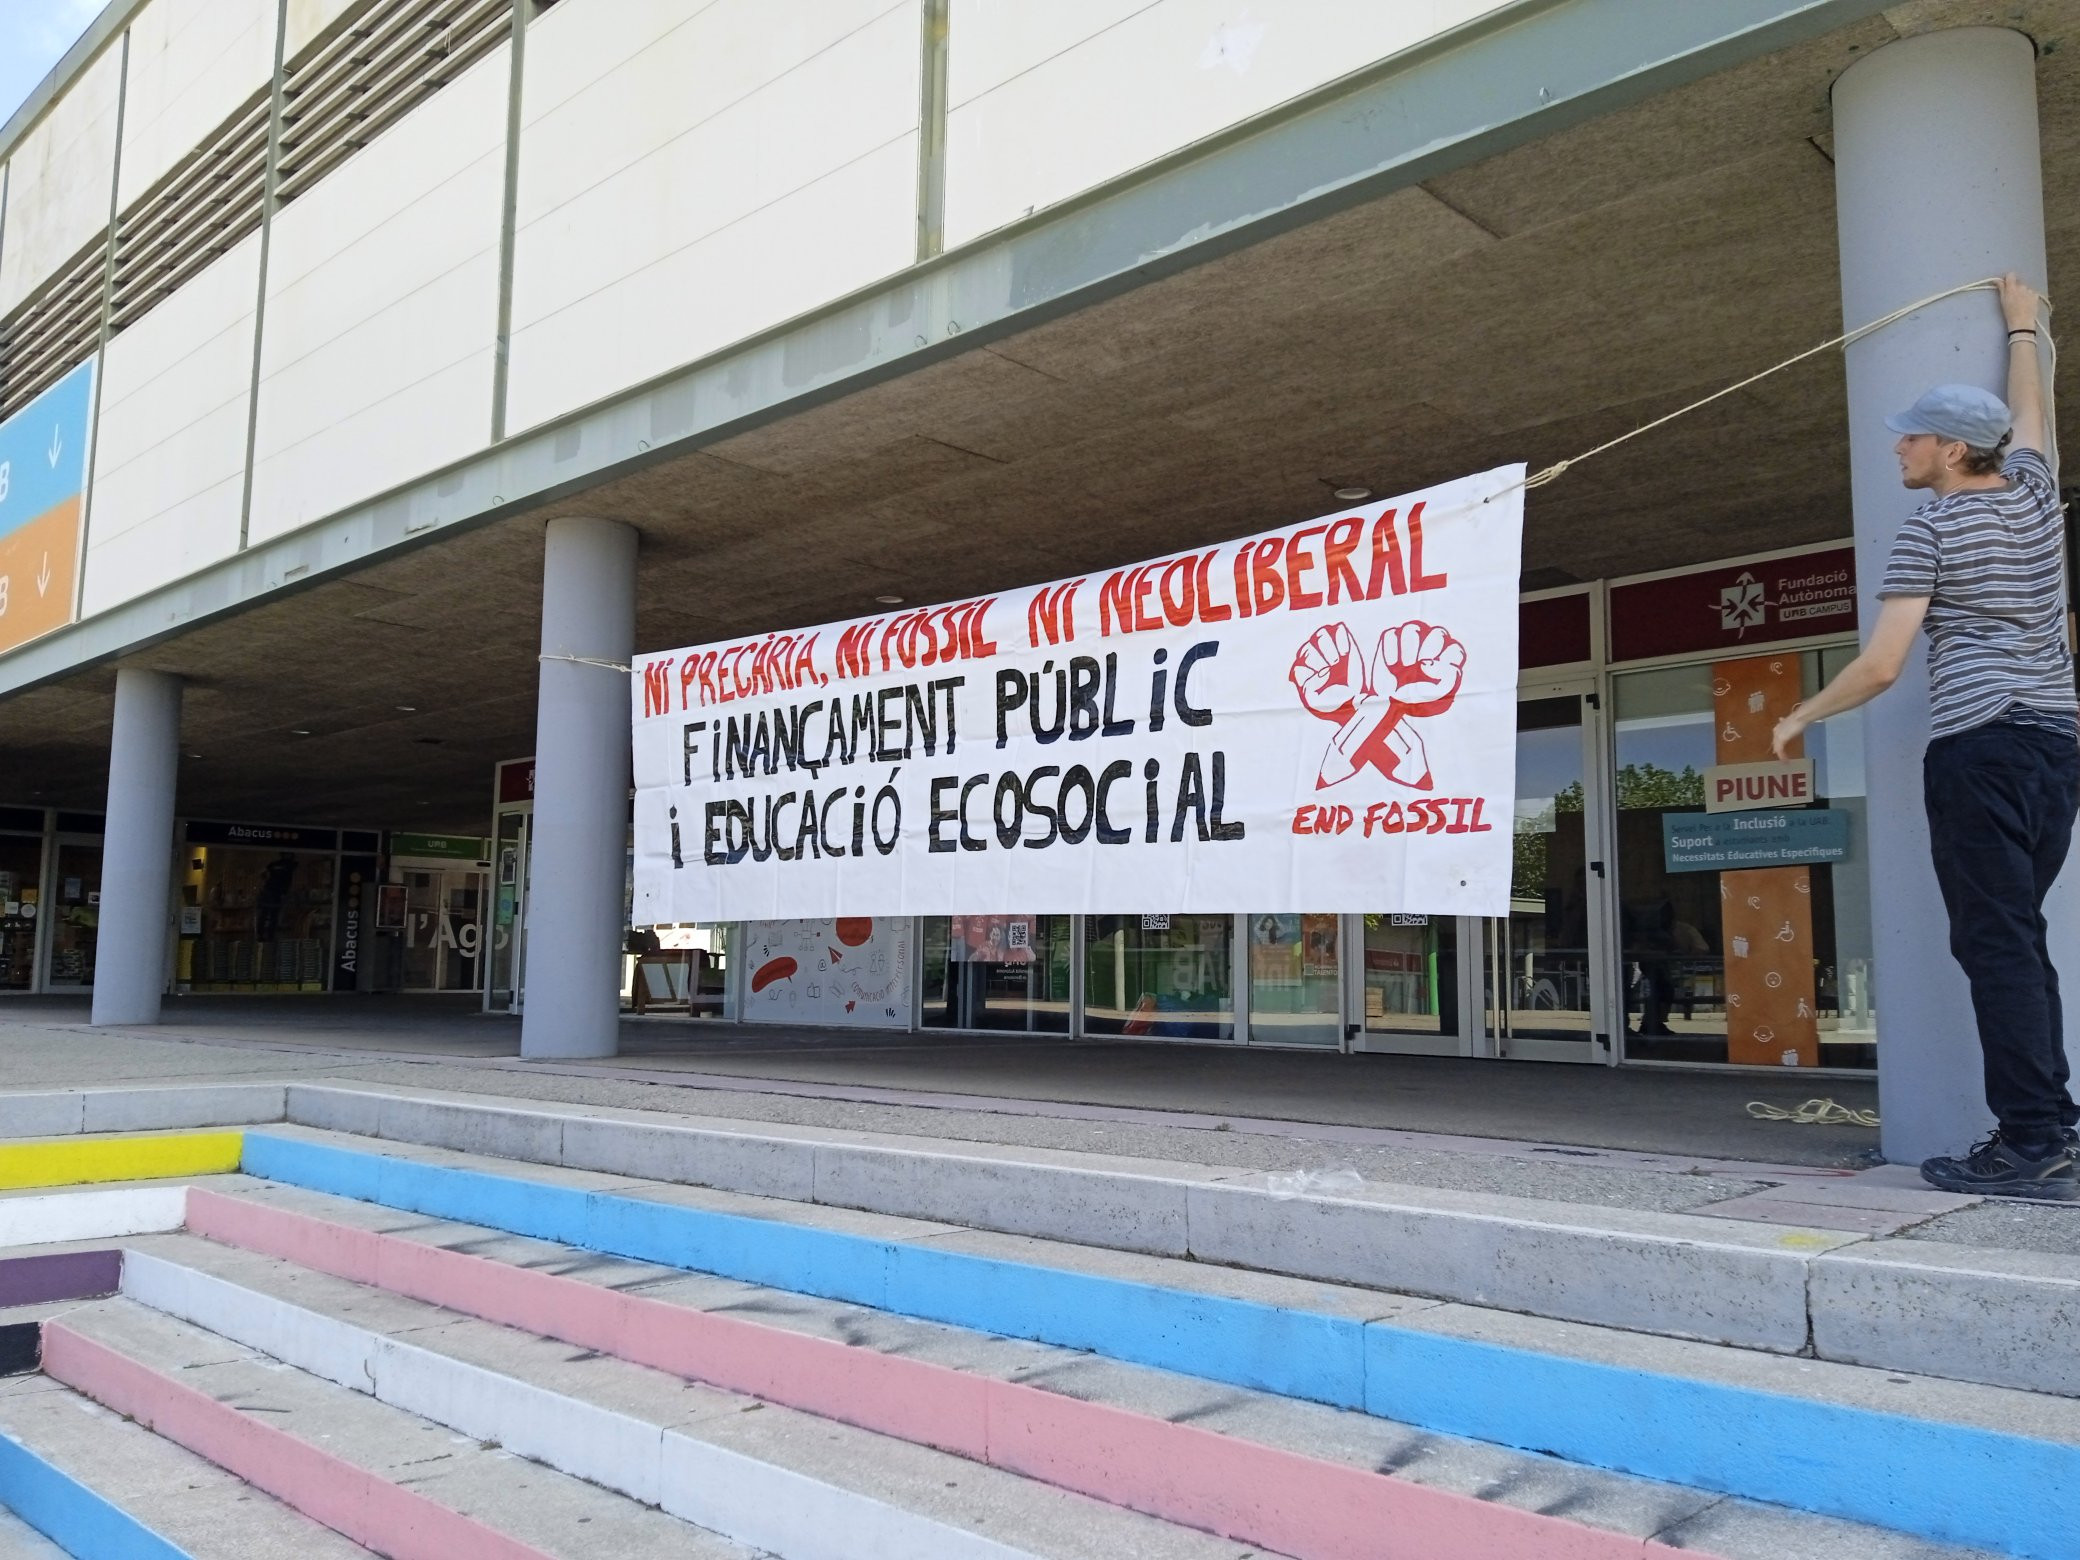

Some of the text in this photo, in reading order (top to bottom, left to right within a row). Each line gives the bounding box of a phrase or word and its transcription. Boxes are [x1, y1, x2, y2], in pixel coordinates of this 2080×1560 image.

[1778, 569, 1848, 591] Fundació
[1778, 585, 1857, 605] Autònoma
[1783, 602, 1849, 619] UAB CAMPUS
[1716, 772, 1807, 803] PIUNE
[1291, 797, 1492, 838] END FOSSIL
[1733, 816, 1786, 830] Inclusió
[228, 825, 273, 839] Abacus
[1671, 835, 1714, 850] Suport
[1672, 851, 1726, 862] Necessitats
[1728, 849, 1779, 860] Educatives
[340, 910, 359, 973] Abacus
